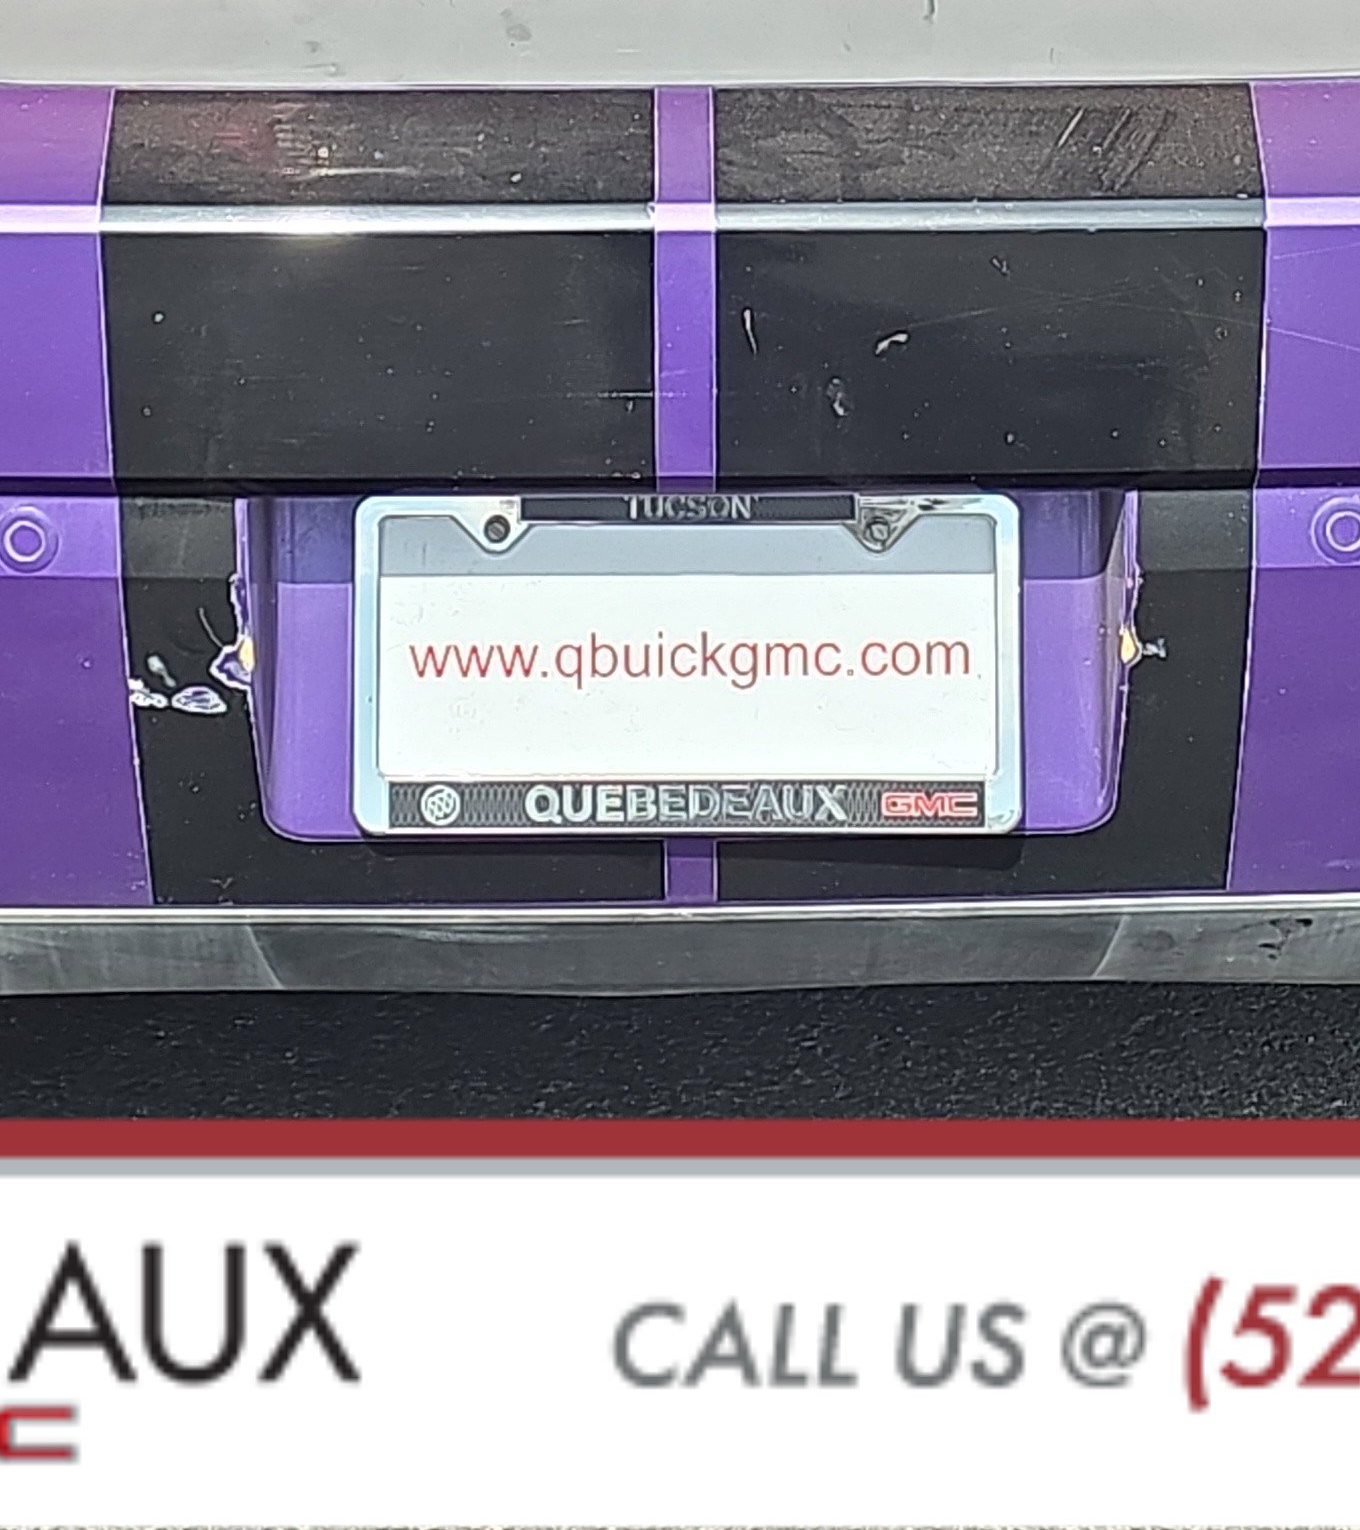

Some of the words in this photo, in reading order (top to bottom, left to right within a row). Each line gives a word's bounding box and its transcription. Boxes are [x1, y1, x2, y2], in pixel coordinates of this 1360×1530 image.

[624, 496, 758, 519] TUCSON
[409, 631, 971, 690] www.qbuickgmc.com
[524, 784, 847, 824] QUEBEDEAUX
[881, 792, 978, 817] GMC
